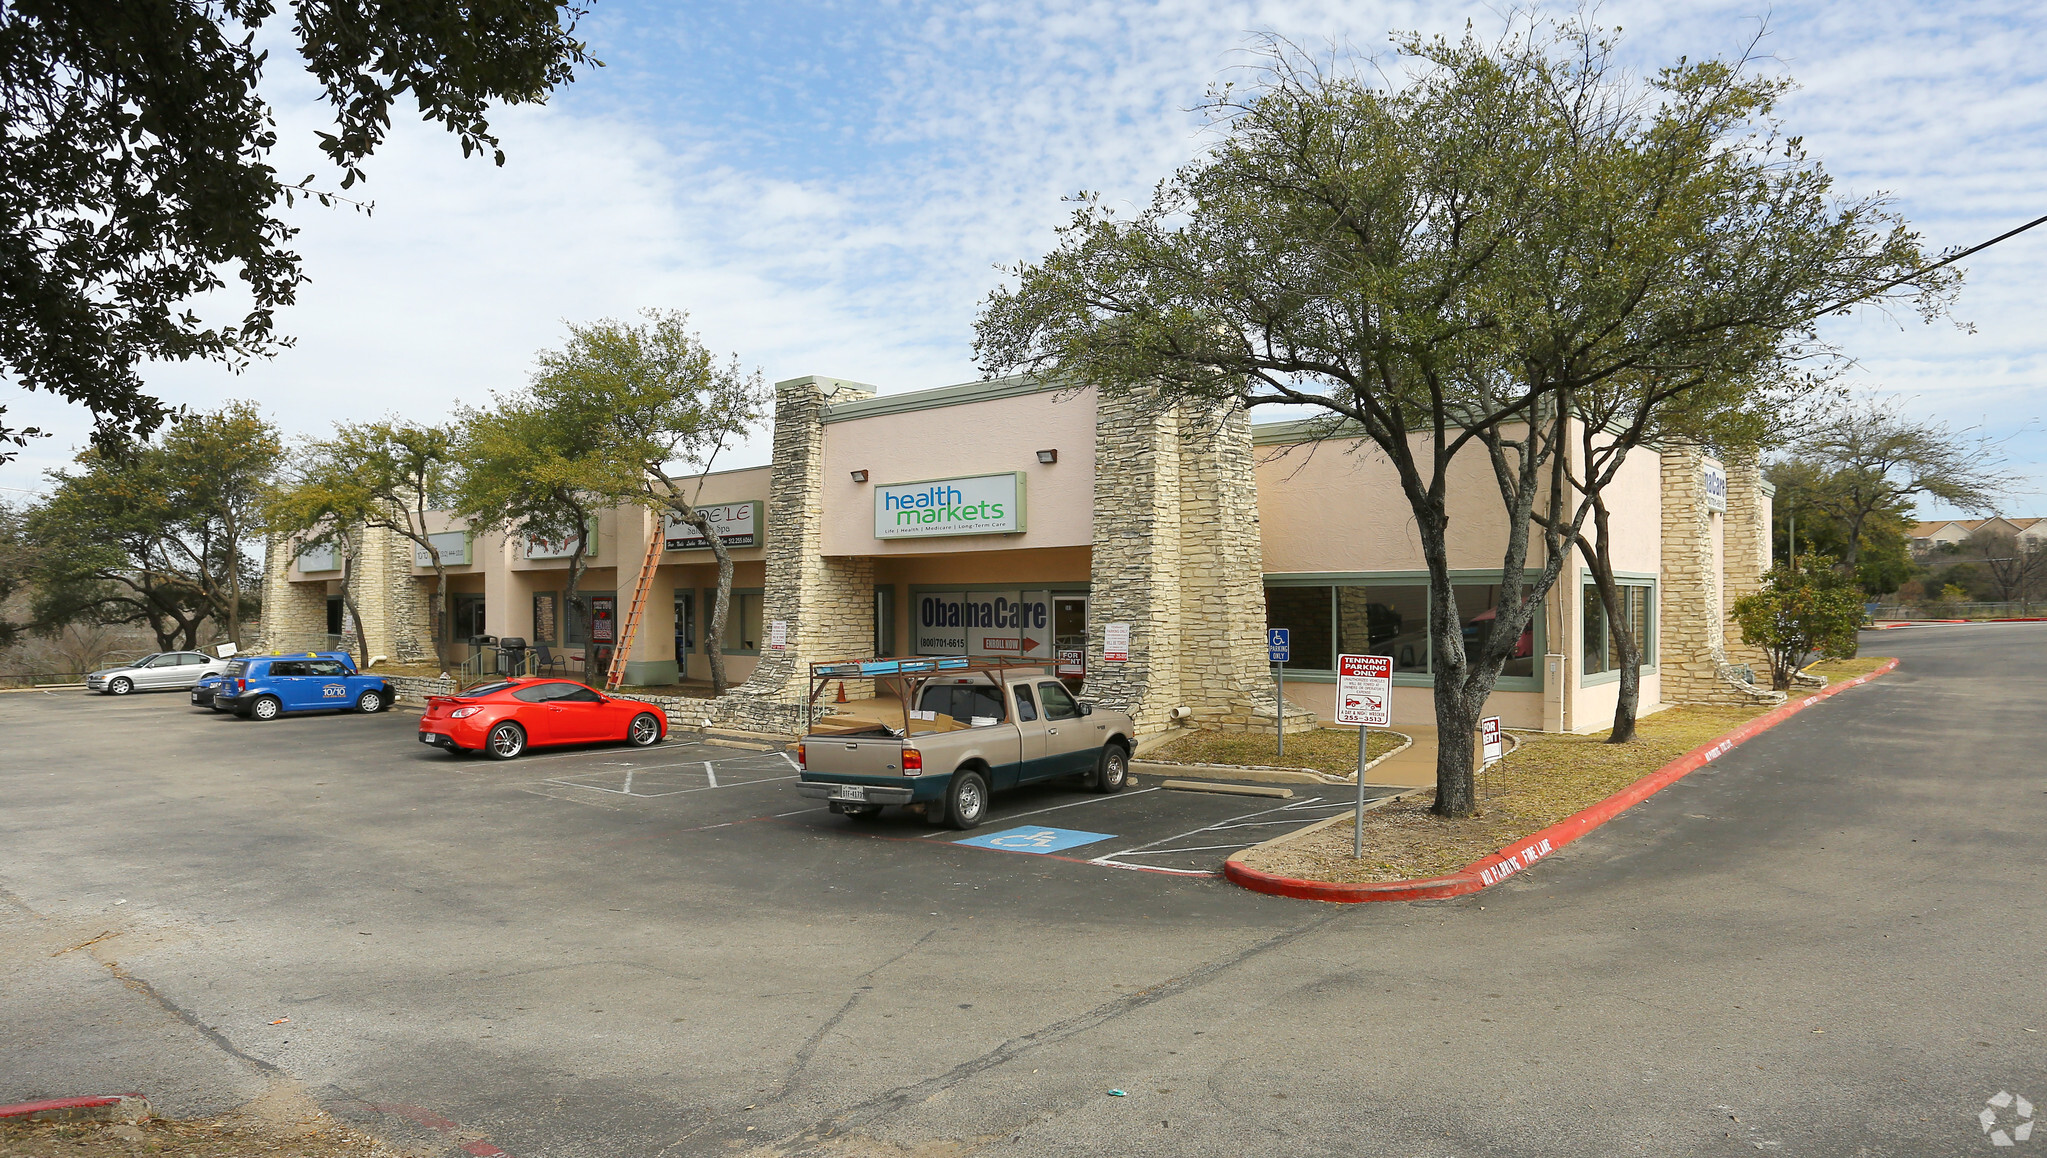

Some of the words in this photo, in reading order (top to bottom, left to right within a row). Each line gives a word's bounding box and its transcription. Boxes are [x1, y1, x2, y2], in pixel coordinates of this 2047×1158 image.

[885, 485, 962, 511] health
[896, 500, 1005, 526] markets
[716, 525, 731, 534] Spa
[921, 596, 1047, 629] ObamaCare
[920, 637, 965, 649] (800)701-6615
[985, 639, 1003, 649] ENROLL
[1004, 639, 1019, 650] NOW
[1272, 652, 1285, 660] ONLY
[1344, 657, 1388, 665] TENNANT
[1344, 663, 1387, 671] PARKING
[322, 688, 346, 696] 10/10
[1484, 721, 1496, 733] FOR
[1480, 869, 1494, 886] NO
[1490, 856, 1522, 881] PARKING
[1520, 846, 1539, 864] FIRE
[1534, 838, 1553, 857] LANE
